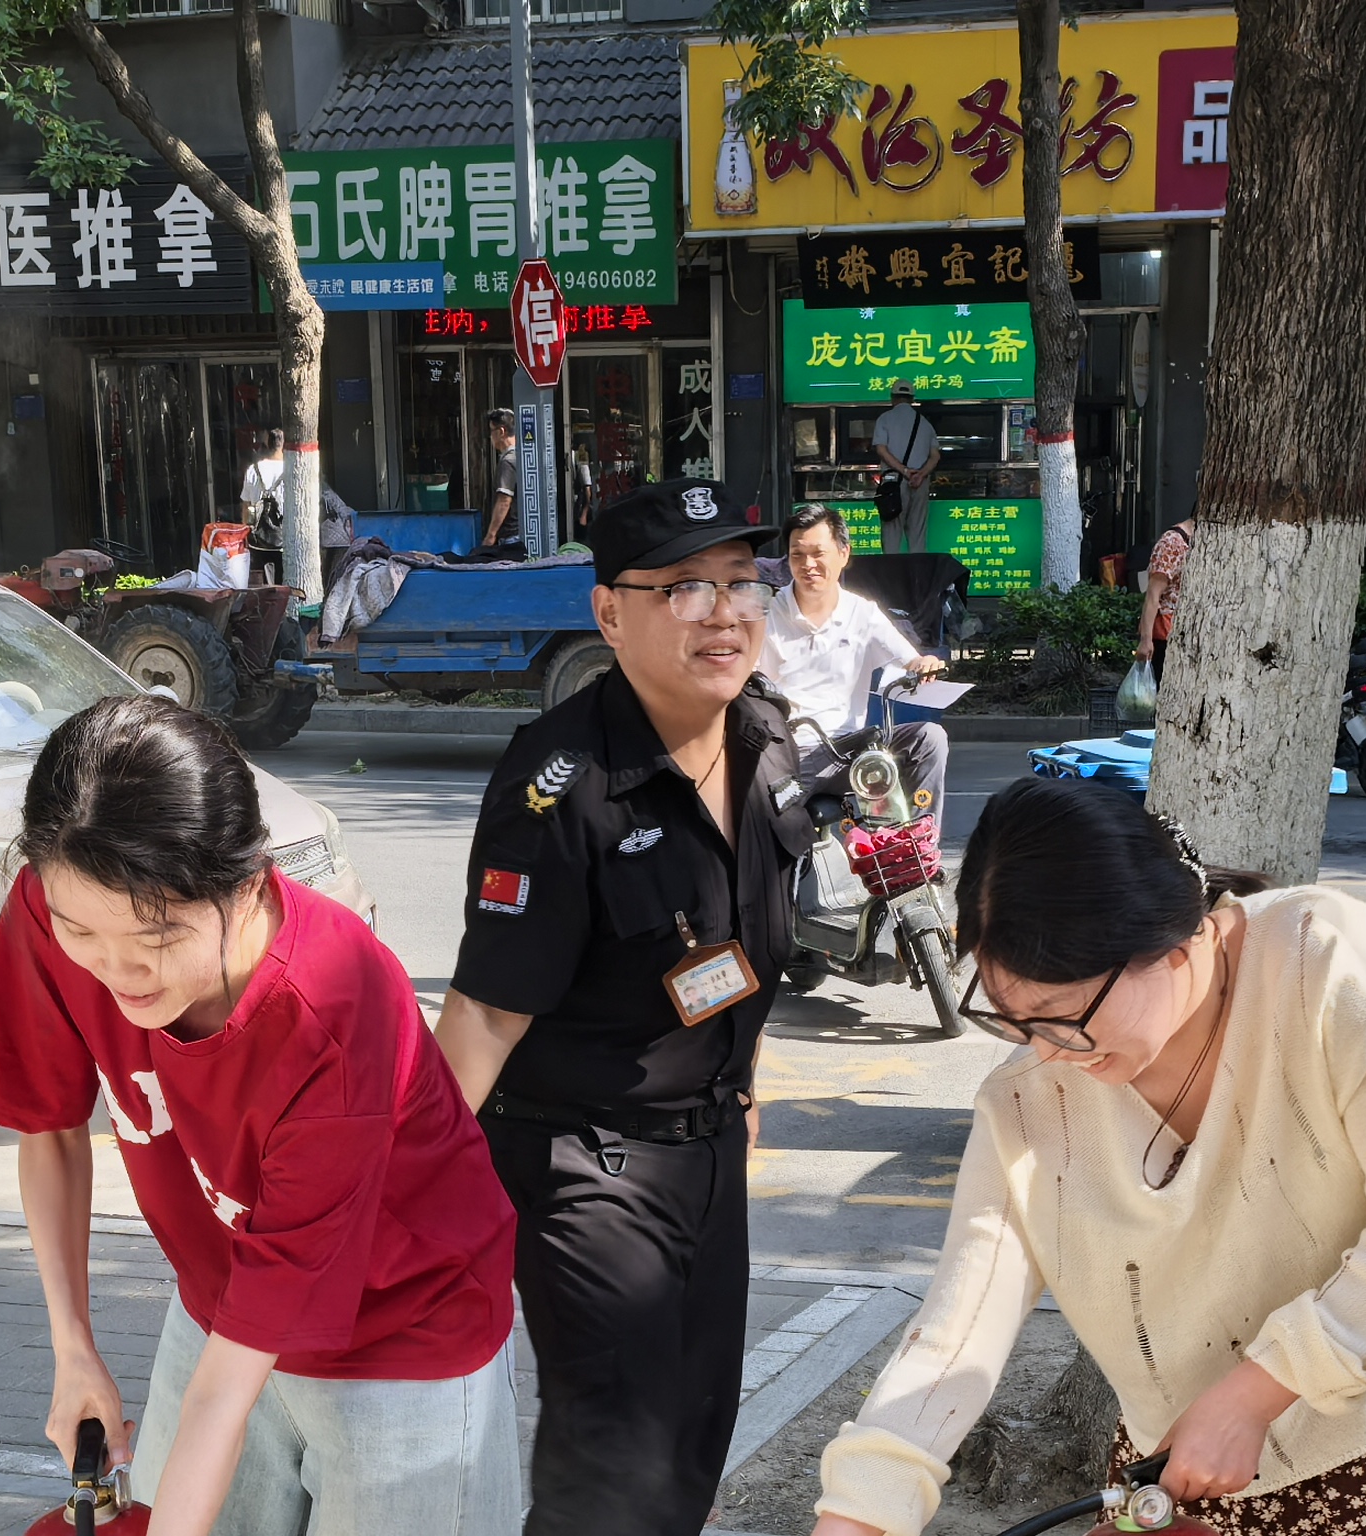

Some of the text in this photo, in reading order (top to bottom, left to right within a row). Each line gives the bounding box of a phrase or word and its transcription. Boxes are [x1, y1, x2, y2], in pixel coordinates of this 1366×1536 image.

[285, 154, 656, 260] 石氏脾胃推拿
[350, 278, 434, 295] 眼健康生活馆
[474, 271, 509, 293] 电话
[520, 278, 560, 367] 停
[806, 326, 1027, 367] 庞记宜兴斋
[913, 374, 964, 390] 桶子鸡
[949, 506, 1019, 519] 本店主营
